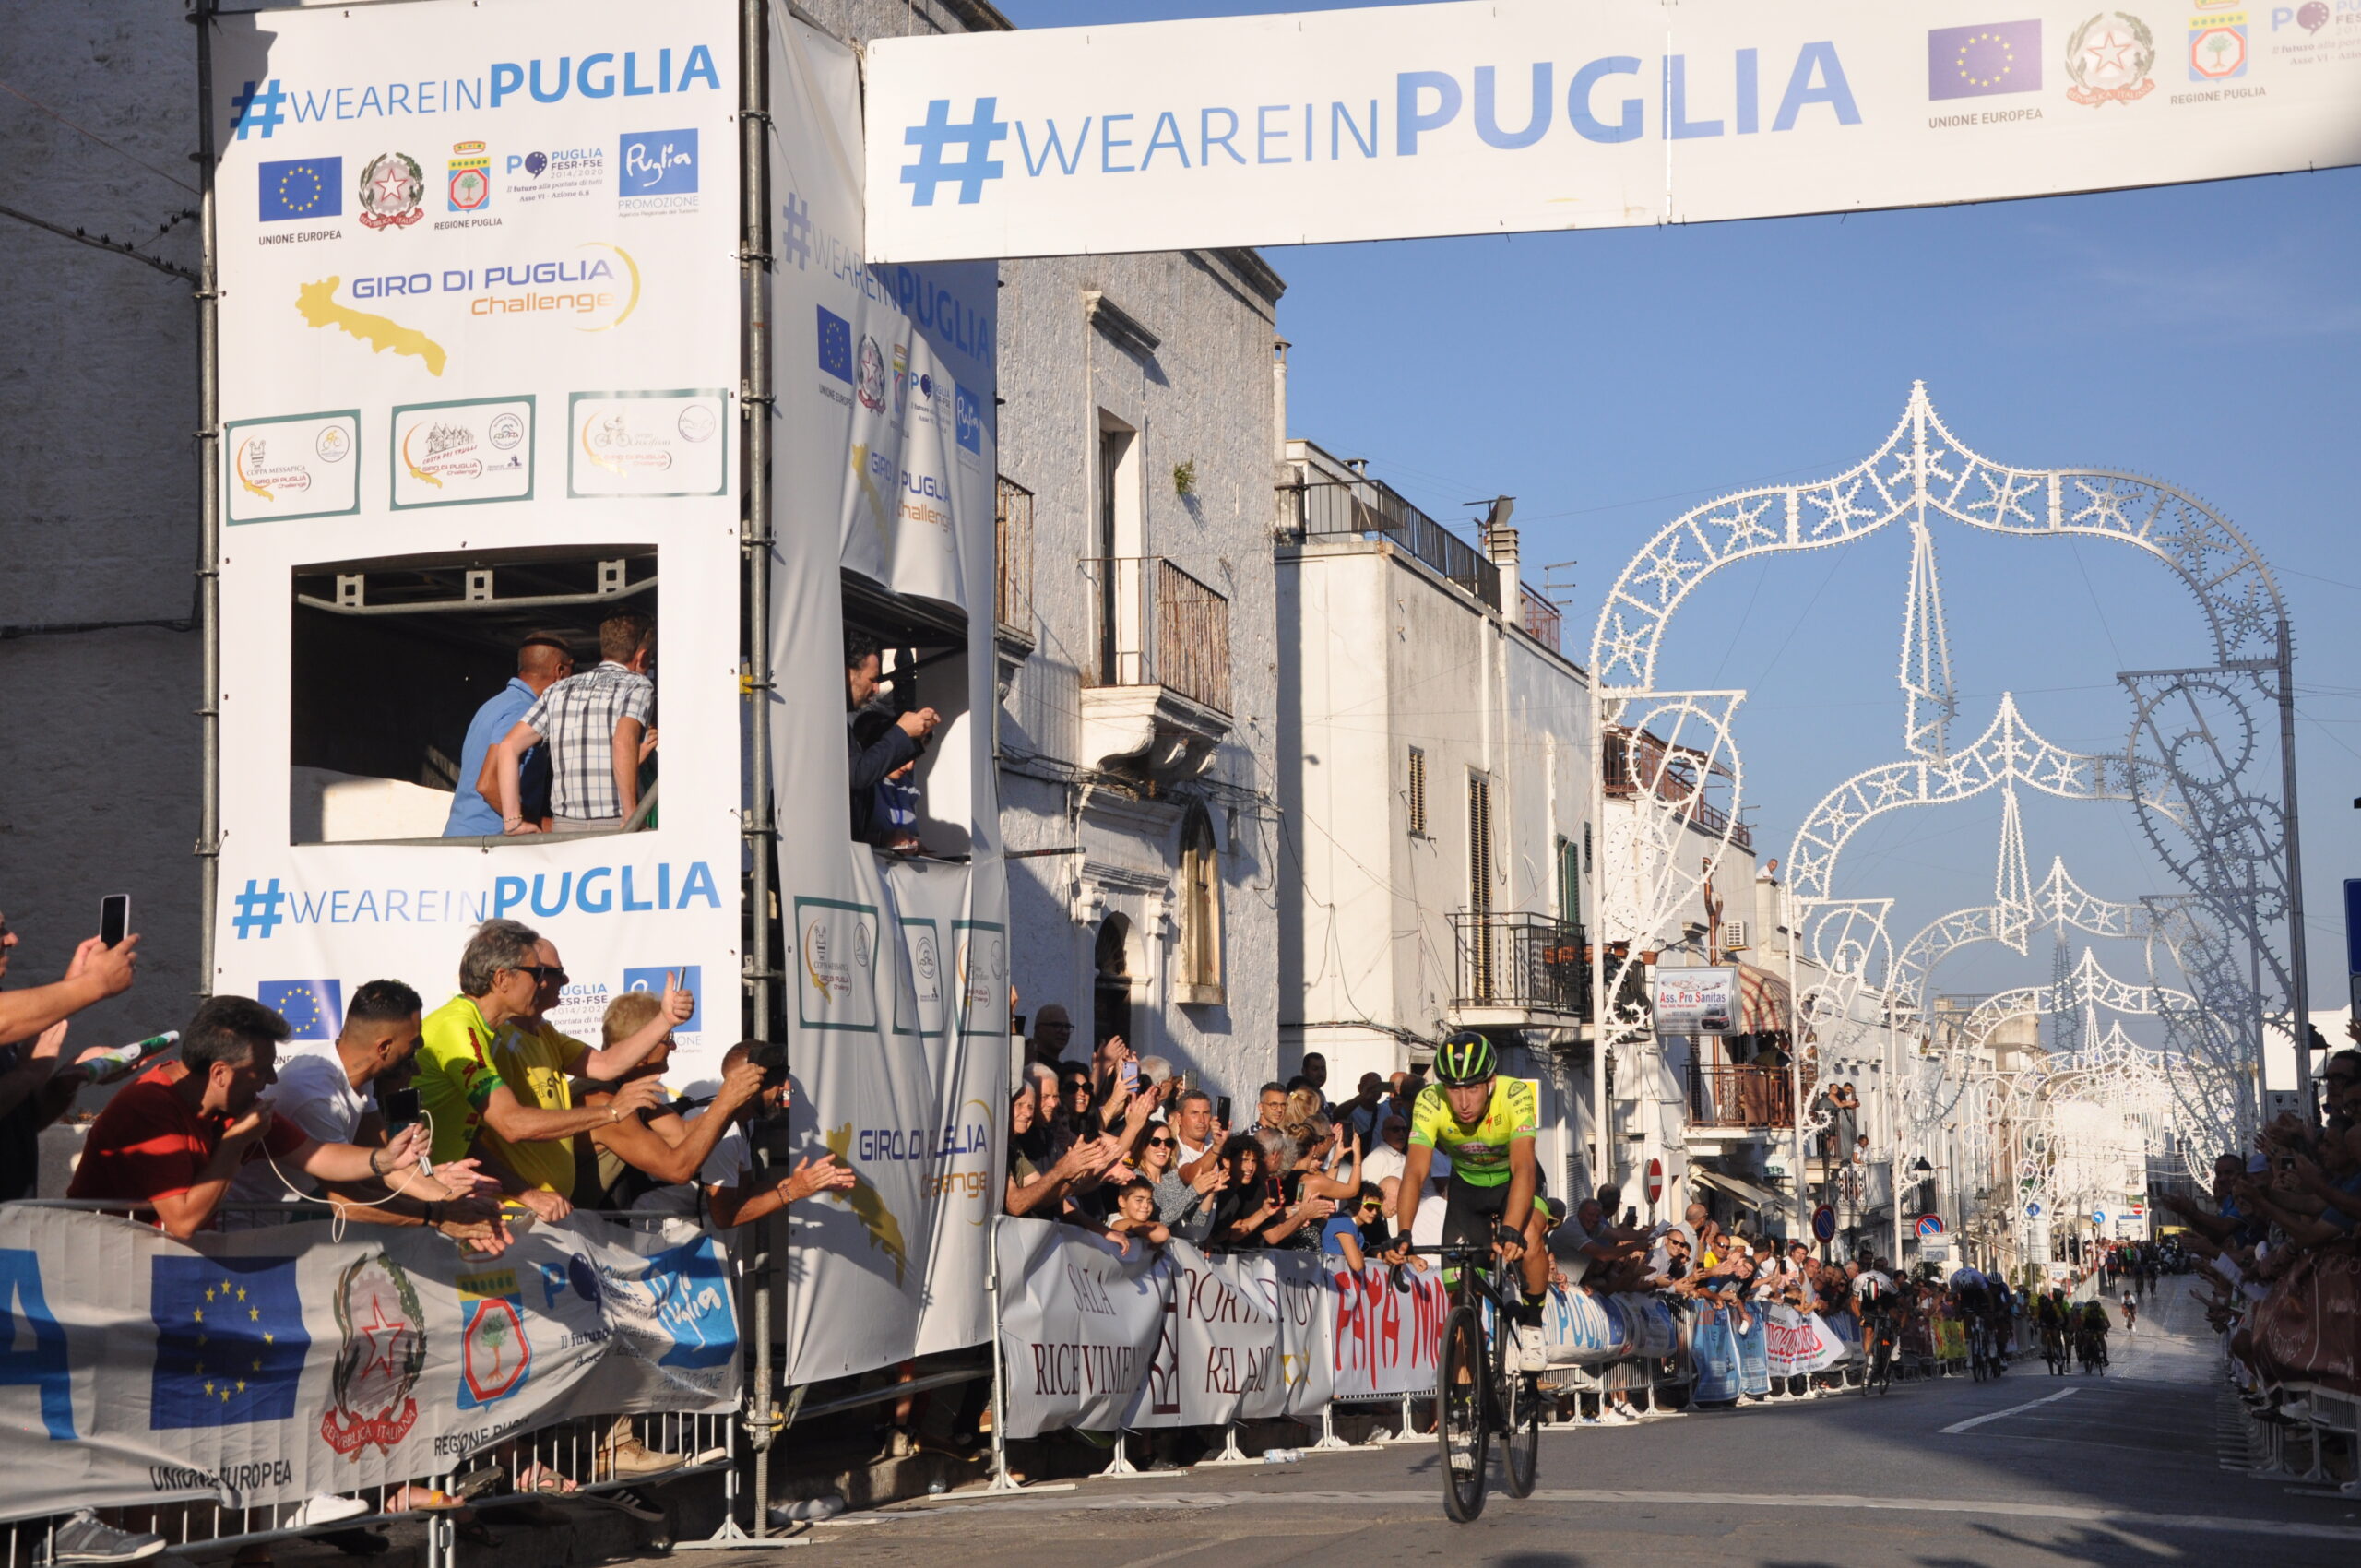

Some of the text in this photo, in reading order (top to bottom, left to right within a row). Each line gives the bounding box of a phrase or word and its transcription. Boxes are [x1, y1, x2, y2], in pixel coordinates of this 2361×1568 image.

[230, 44, 721, 140] #WEAREINPUGLIA
[2170, 87, 2266, 106] REGIONE PUGLIA
[900, 41, 1862, 206] #WEAREINPUGLIA
[1928, 109, 2043, 129] UNIONE EUROPEA
[552, 148, 603, 161] PUGLIA
[550, 168, 603, 180] 2014/2020
[626, 143, 692, 187] Puglia
[552, 181, 578, 192] portata
[519, 195, 536, 203] Asse
[552, 190, 577, 200] Azione
[619, 196, 699, 210] PROMOZIONE
[434, 218, 503, 231] REGIONE PUGLIA
[258, 230, 342, 246] UNIONE EUROPEA
[352, 259, 614, 299] GIRO DI PUGLIA
[901, 469, 950, 503] PUGLIA
[232, 861, 721, 940] #WEAREINPUGLIA
[557, 983, 608, 996] UGLIA
[1660, 992, 1726, 1004] Ass. Pro Sanitas
[1925, 1250, 1946, 1262] 50
[1067, 1263, 1117, 1316] SALA
[649, 1271, 722, 1353] Puglia
[571, 1328, 610, 1347] futuro
[323, 1408, 416, 1449] REPVBBLICA ITALIANA
[150, 1466, 220, 1491] UNIONE
